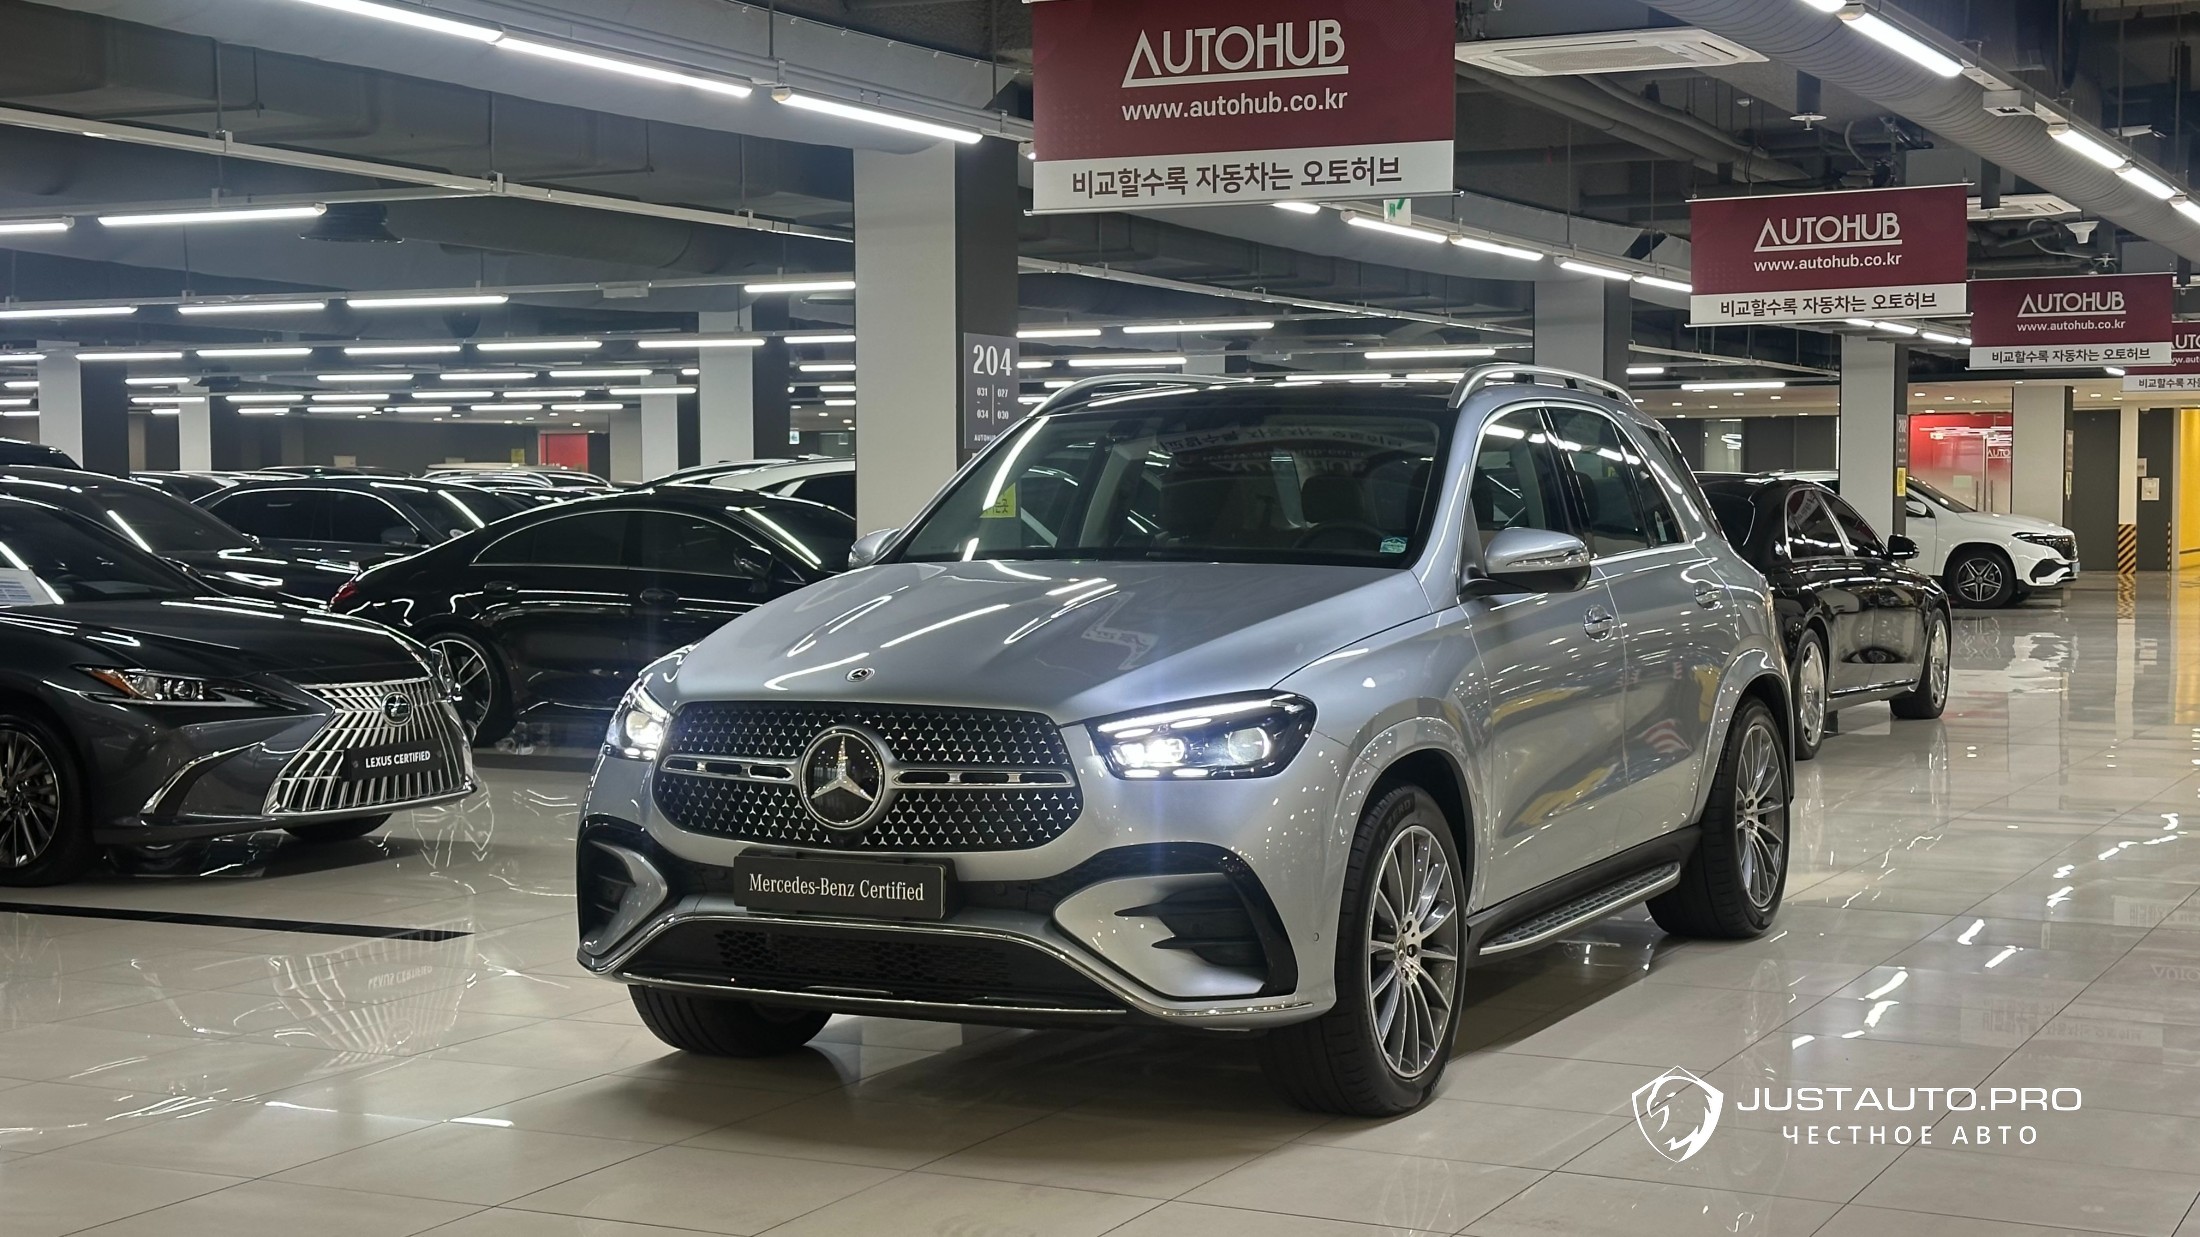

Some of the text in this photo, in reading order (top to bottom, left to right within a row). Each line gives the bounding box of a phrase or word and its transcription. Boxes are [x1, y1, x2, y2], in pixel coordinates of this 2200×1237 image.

[1122, 19, 1349, 88] AUTOHUB
[1122, 88, 1348, 121] www.autohub.co.kr
[1073, 156, 1402, 198] 비교할수록 자동차는 오토허브
[1754, 212, 1902, 252] AUTOHUB
[1754, 252, 1902, 272] www.autohub.co.kr
[1721, 292, 1937, 317] 비교할수록 자동차는 오토허브
[2017, 291, 2126, 318] AUTOHUB
[2017, 319, 2126, 332] www.autohub.co.kr
[973, 345, 1012, 376] 204
[1992, 347, 2150, 363] 비교할수록 자동차는 오토허브
[977, 387, 988, 397] 031
[997, 388, 1008, 398] 027
[977, 409, 989, 419] 034
[997, 410, 1009, 420] 030
[366, 750, 431, 769] LEXUS CERTIFIED
[749, 873, 925, 901] Mercedes-Benz Certified
